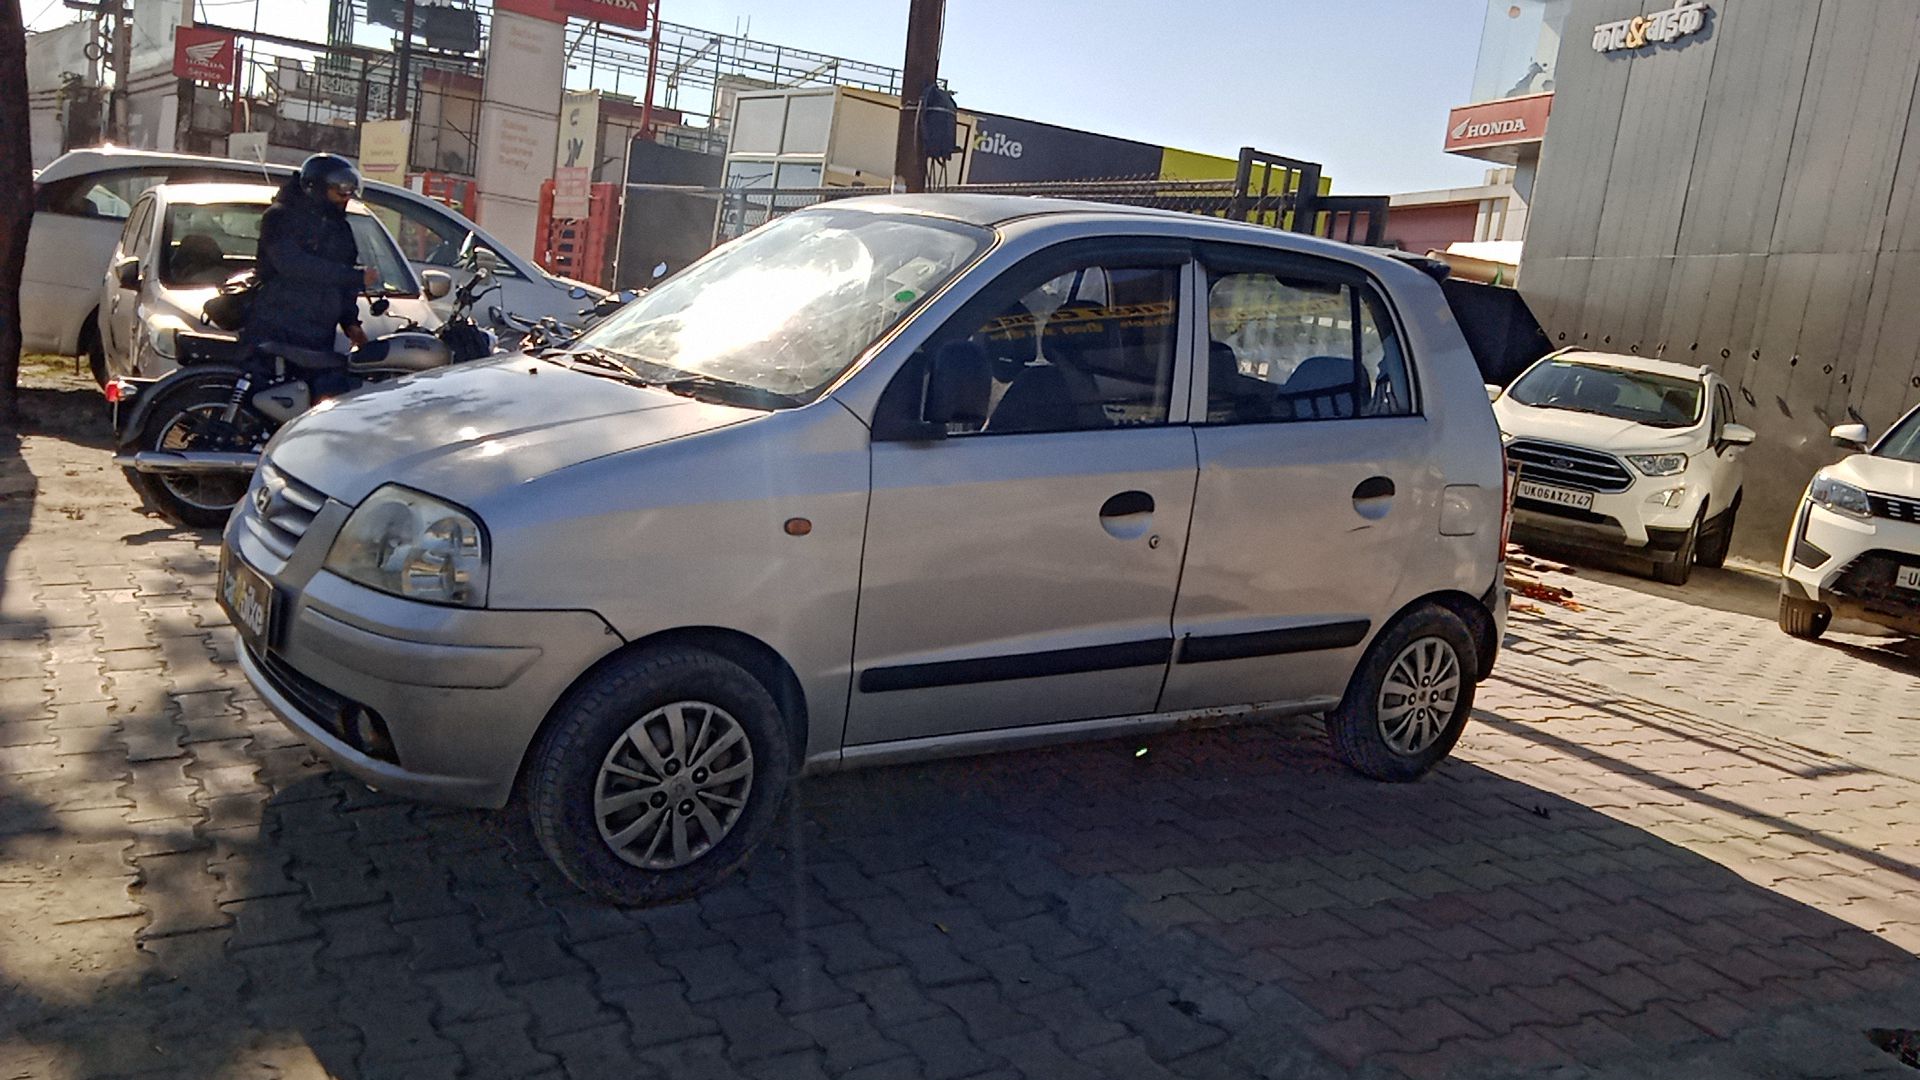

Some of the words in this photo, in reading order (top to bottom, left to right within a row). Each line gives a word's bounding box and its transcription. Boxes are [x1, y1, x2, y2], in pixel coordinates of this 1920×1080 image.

[1466, 118, 1527, 138] HONDA
[1523, 485, 1591, 507] UK06AX2147
[1908, 572, 1920, 587] U
